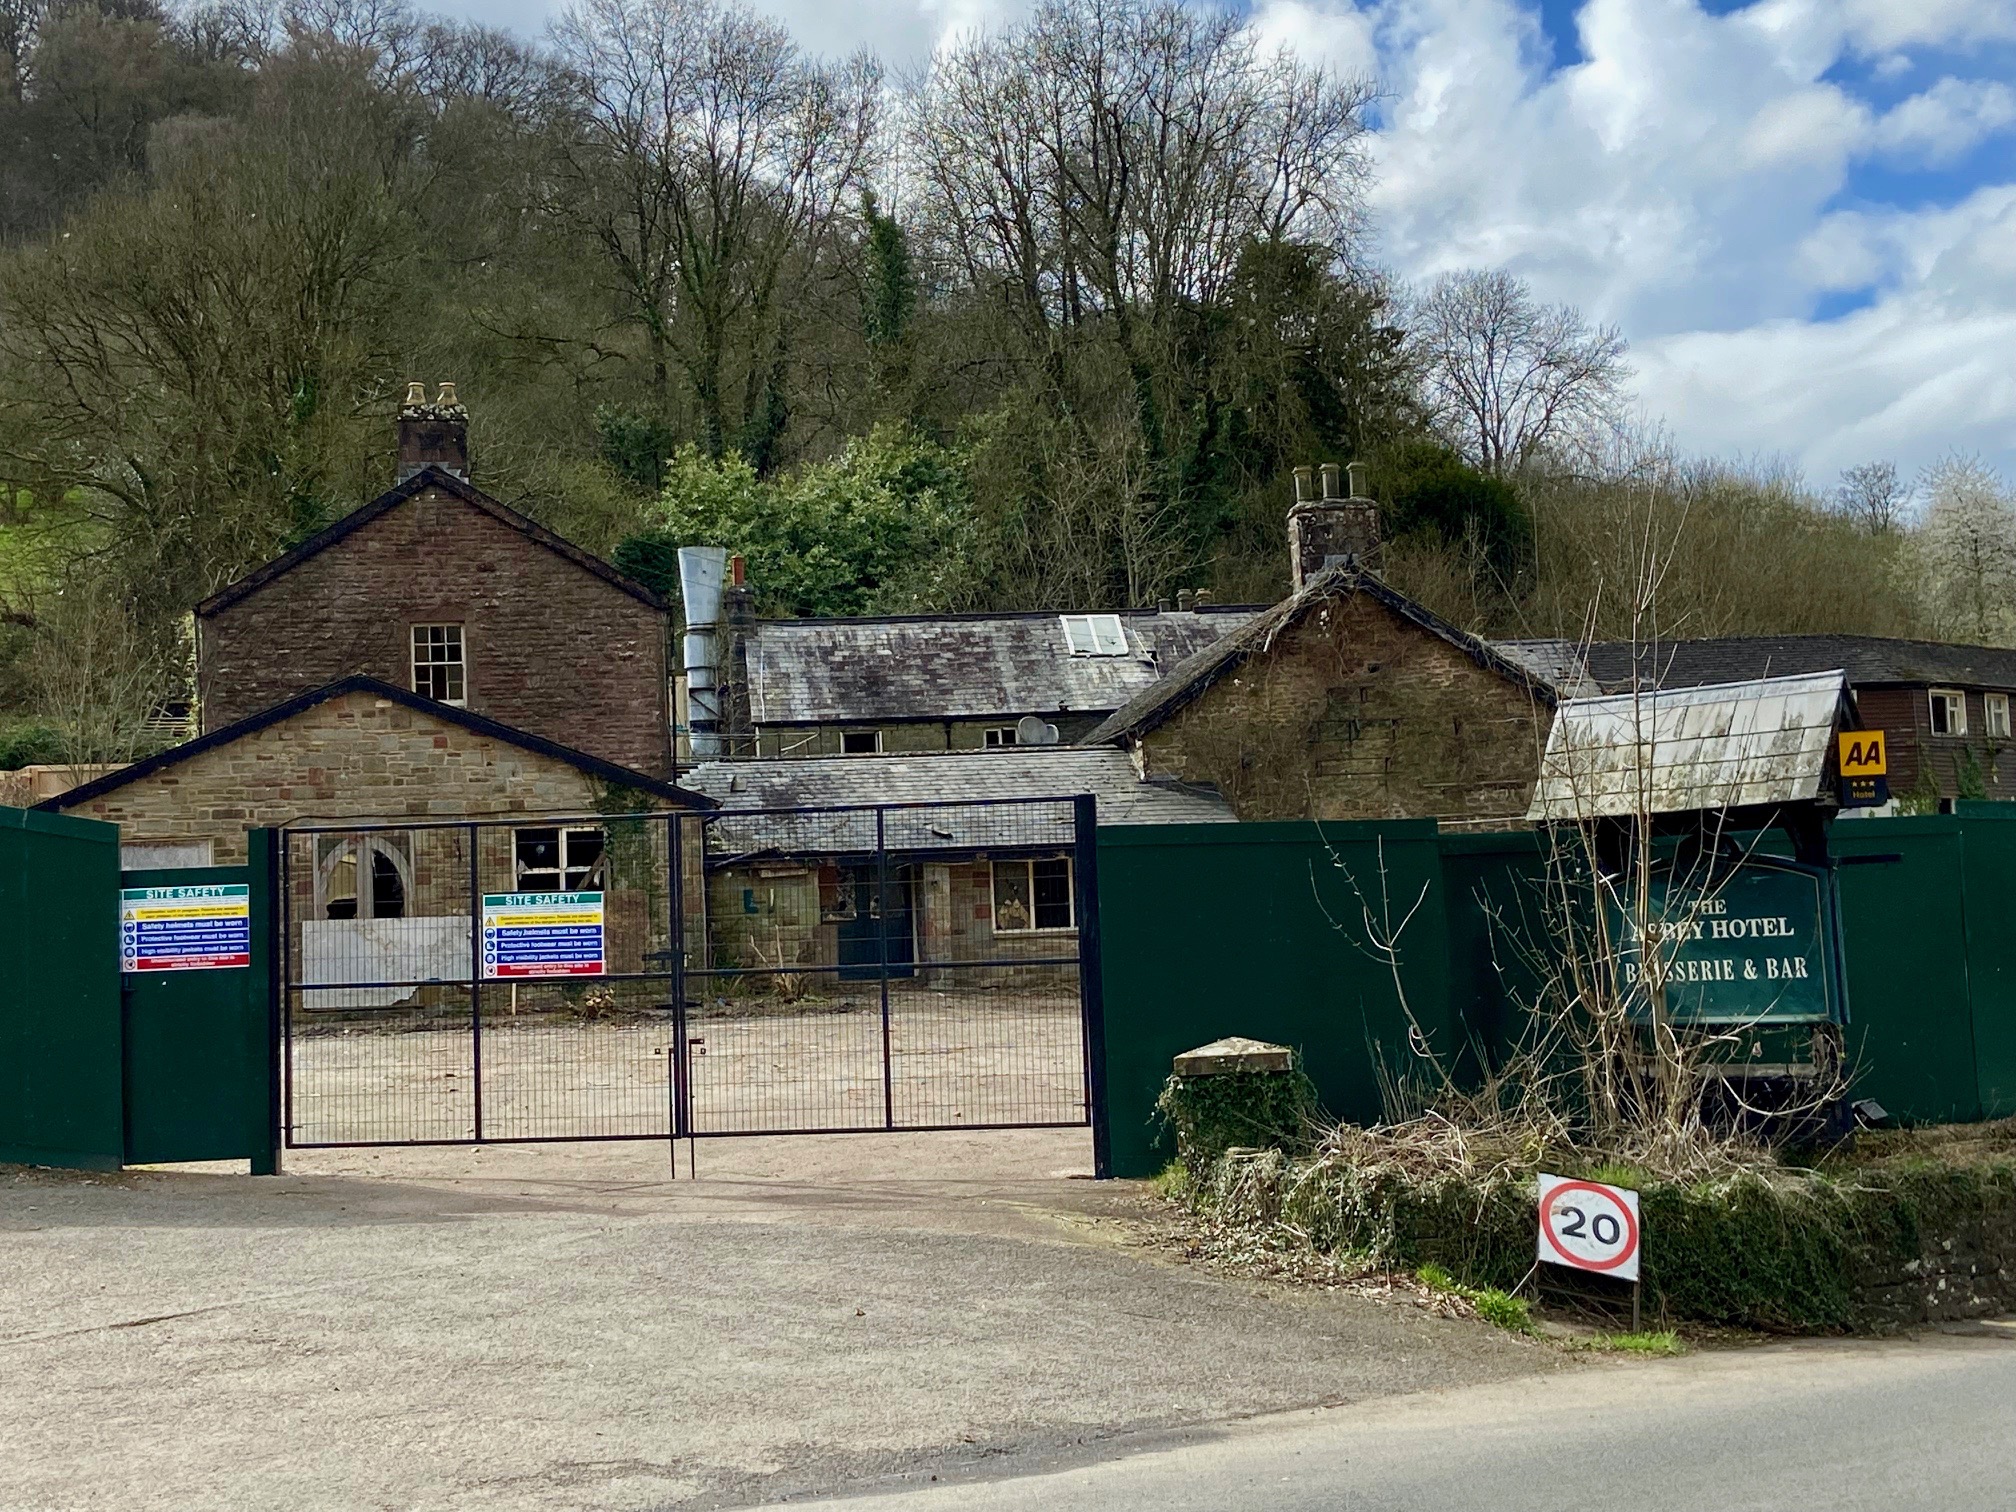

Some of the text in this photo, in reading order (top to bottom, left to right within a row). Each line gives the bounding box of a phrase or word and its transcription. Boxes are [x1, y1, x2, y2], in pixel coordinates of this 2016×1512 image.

[1844, 741, 1880, 766] AA
[1852, 790, 1876, 798] Hotel
[146, 887, 225, 899] SITE SAFETY
[506, 894, 580, 905] SITE SAFETY
[1688, 900, 1726, 914] THE
[141, 922, 164, 930] Safety
[166, 921, 194, 929] helmets
[1710, 917, 1794, 938] HOTEL
[1625, 956, 1808, 982] BSSERIE & BAR
[1561, 1206, 1620, 1245] 20
